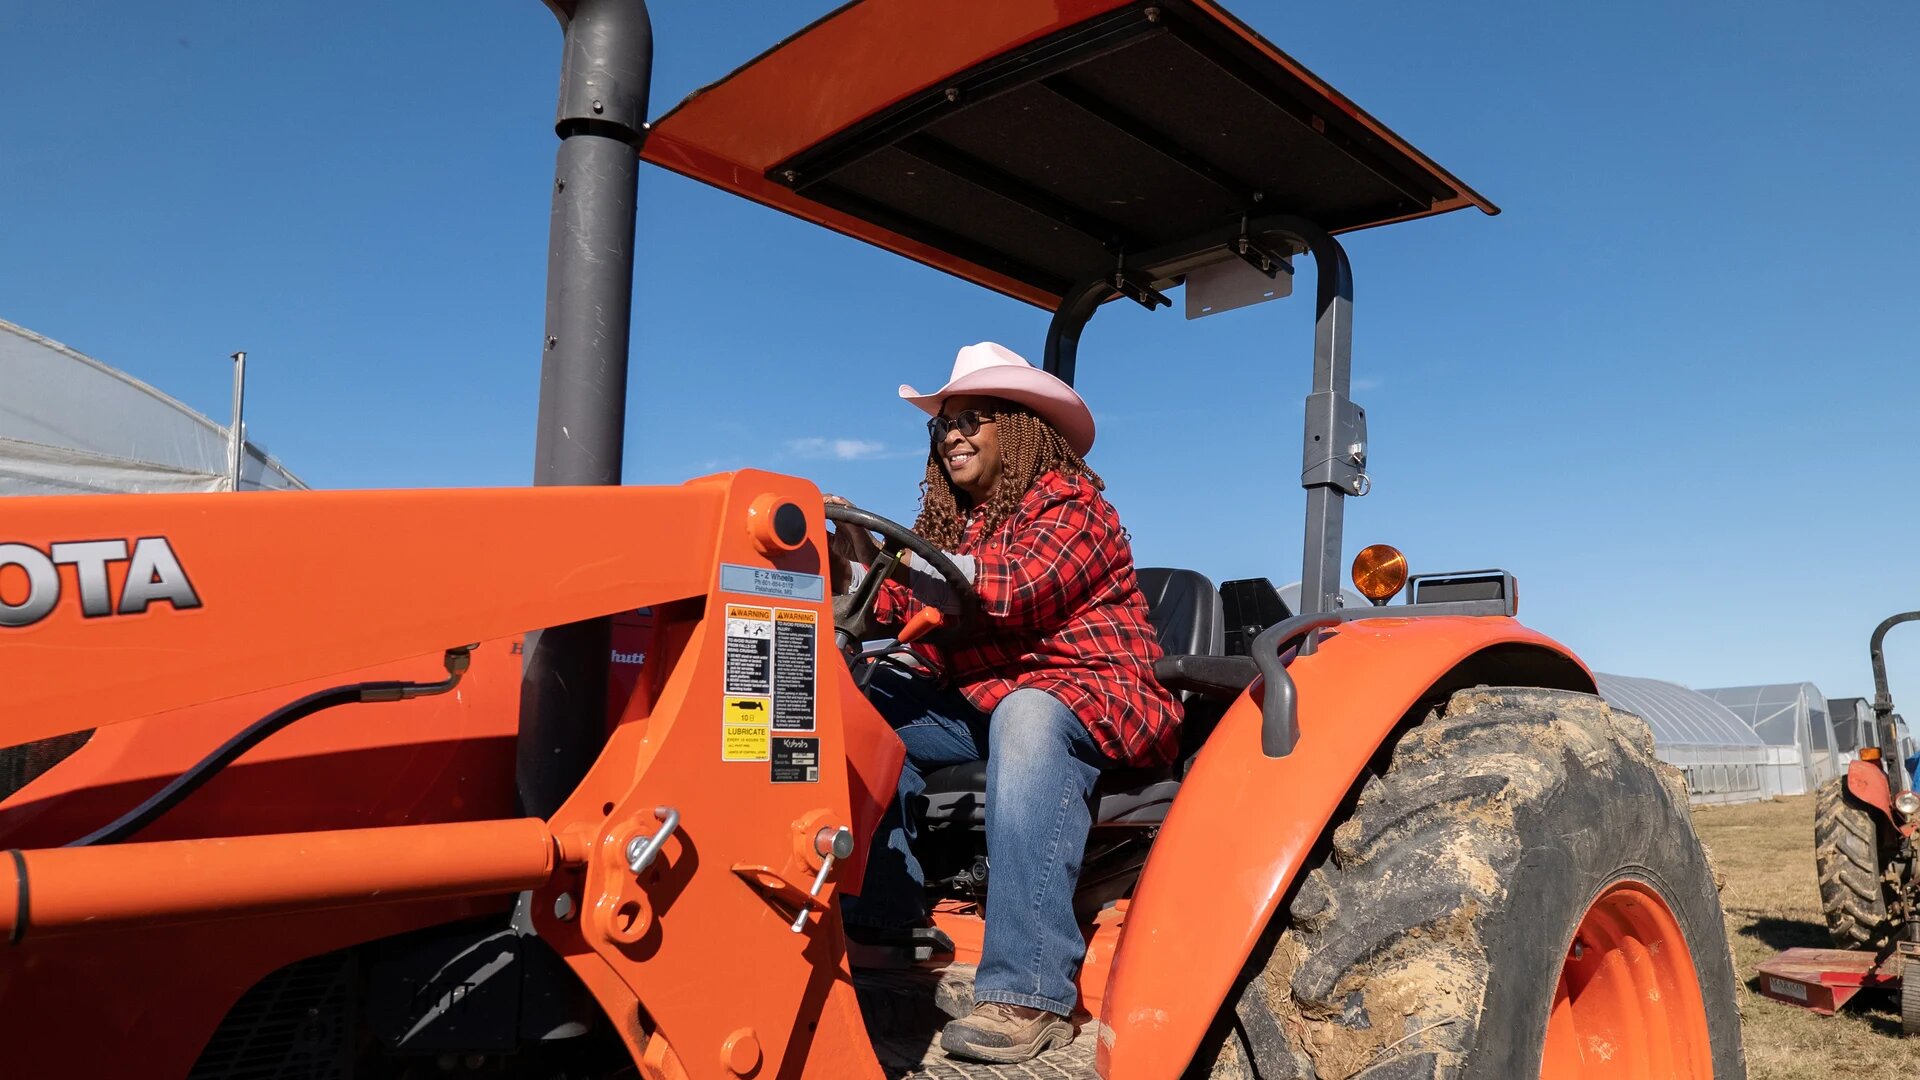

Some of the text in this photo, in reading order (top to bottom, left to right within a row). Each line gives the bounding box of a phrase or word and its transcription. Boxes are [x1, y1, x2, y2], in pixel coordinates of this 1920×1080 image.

[736, 610, 770, 619] WARNING
[783, 612, 814, 621] WARNING
[611, 649, 645, 664] hutt
